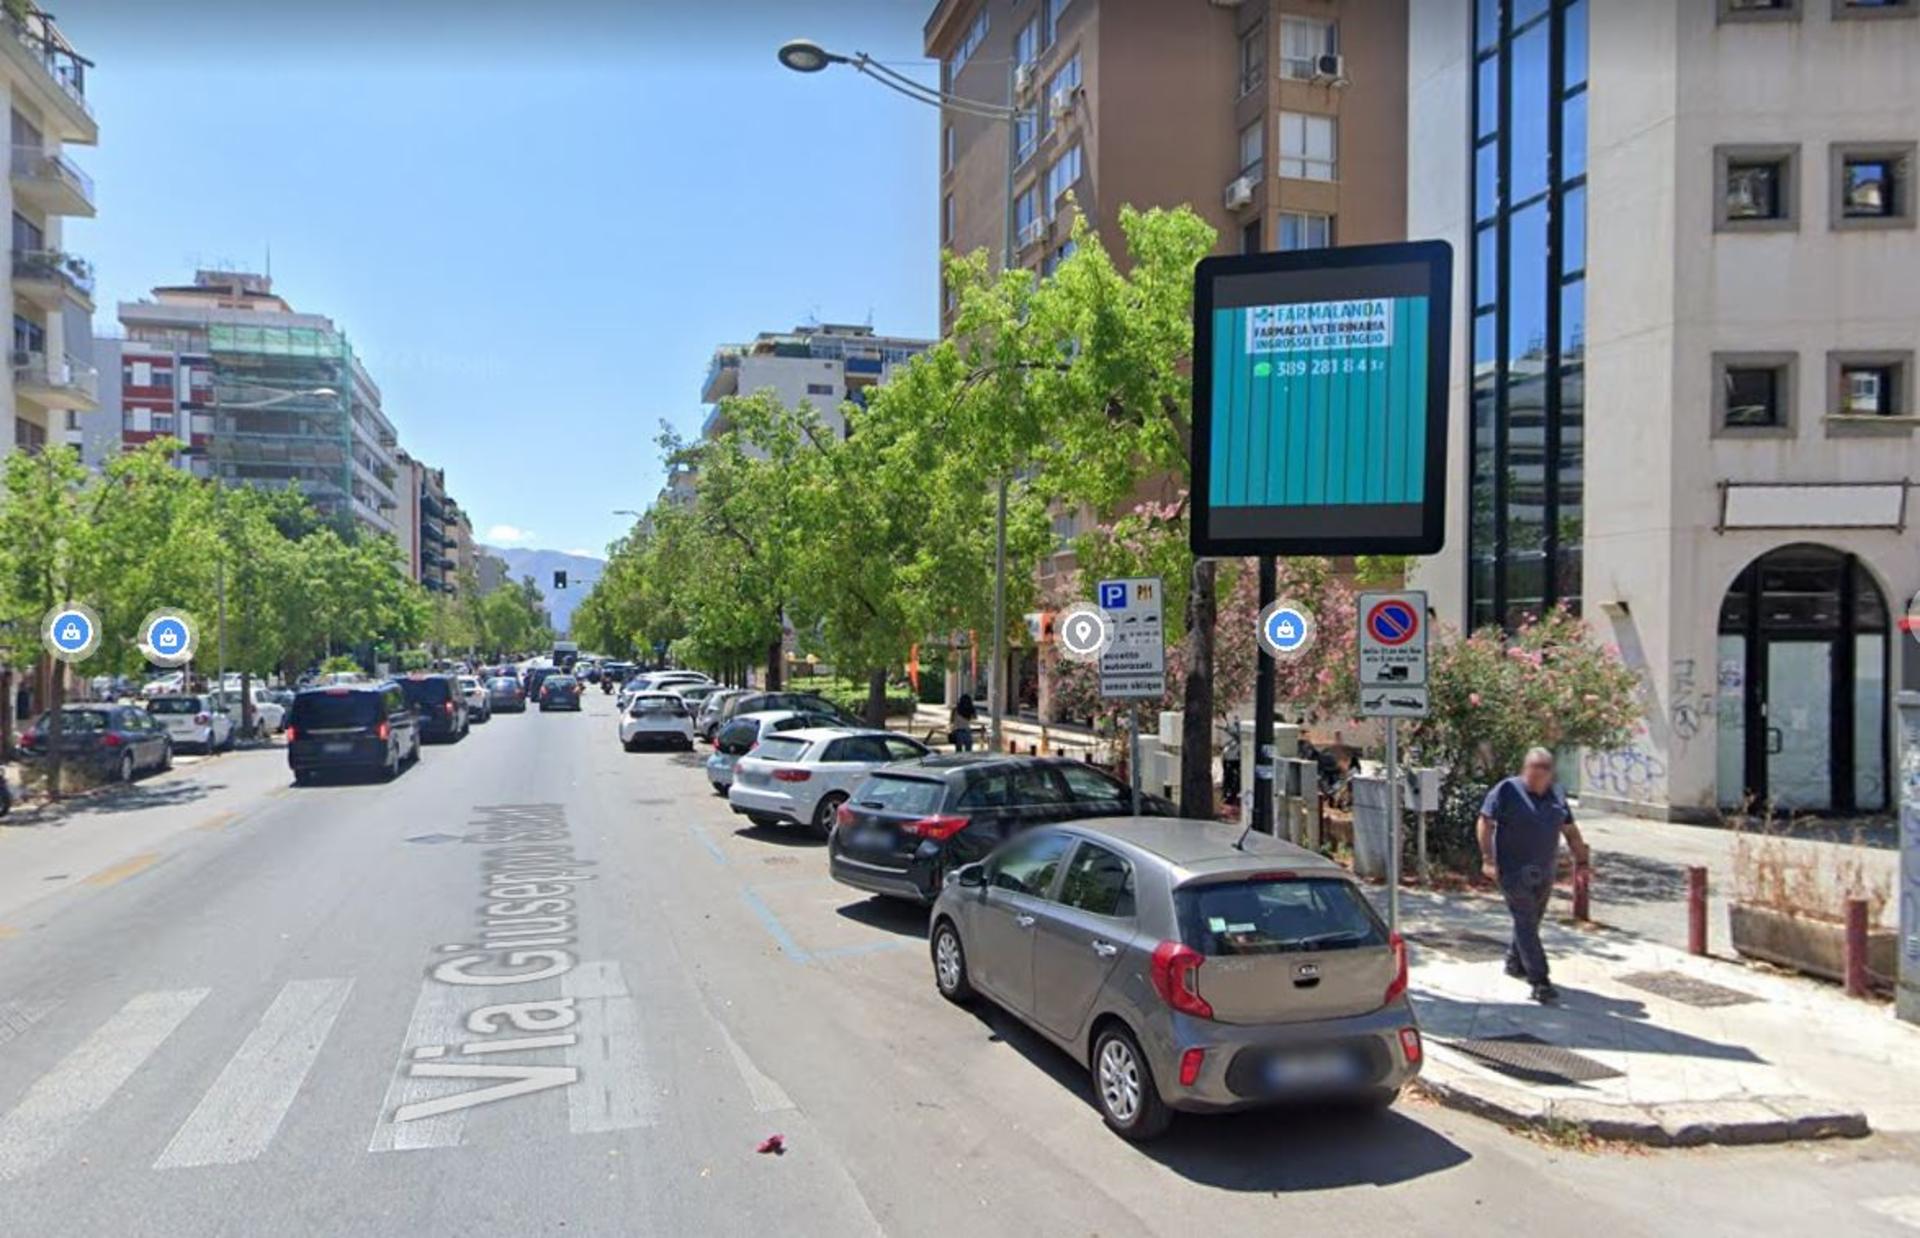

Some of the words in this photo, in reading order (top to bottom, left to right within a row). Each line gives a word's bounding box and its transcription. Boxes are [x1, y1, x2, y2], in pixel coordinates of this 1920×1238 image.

[1278, 301, 1384, 321] FARMALANDA
[1255, 324, 1308, 338] FARMACIA
[1312, 320, 1385, 335] VETERINARIA
[1255, 337, 1311, 350] INGROSSO
[1277, 360, 1306, 377] 389
[1311, 358, 1338, 375] 281
[1107, 586, 1123, 606] P
